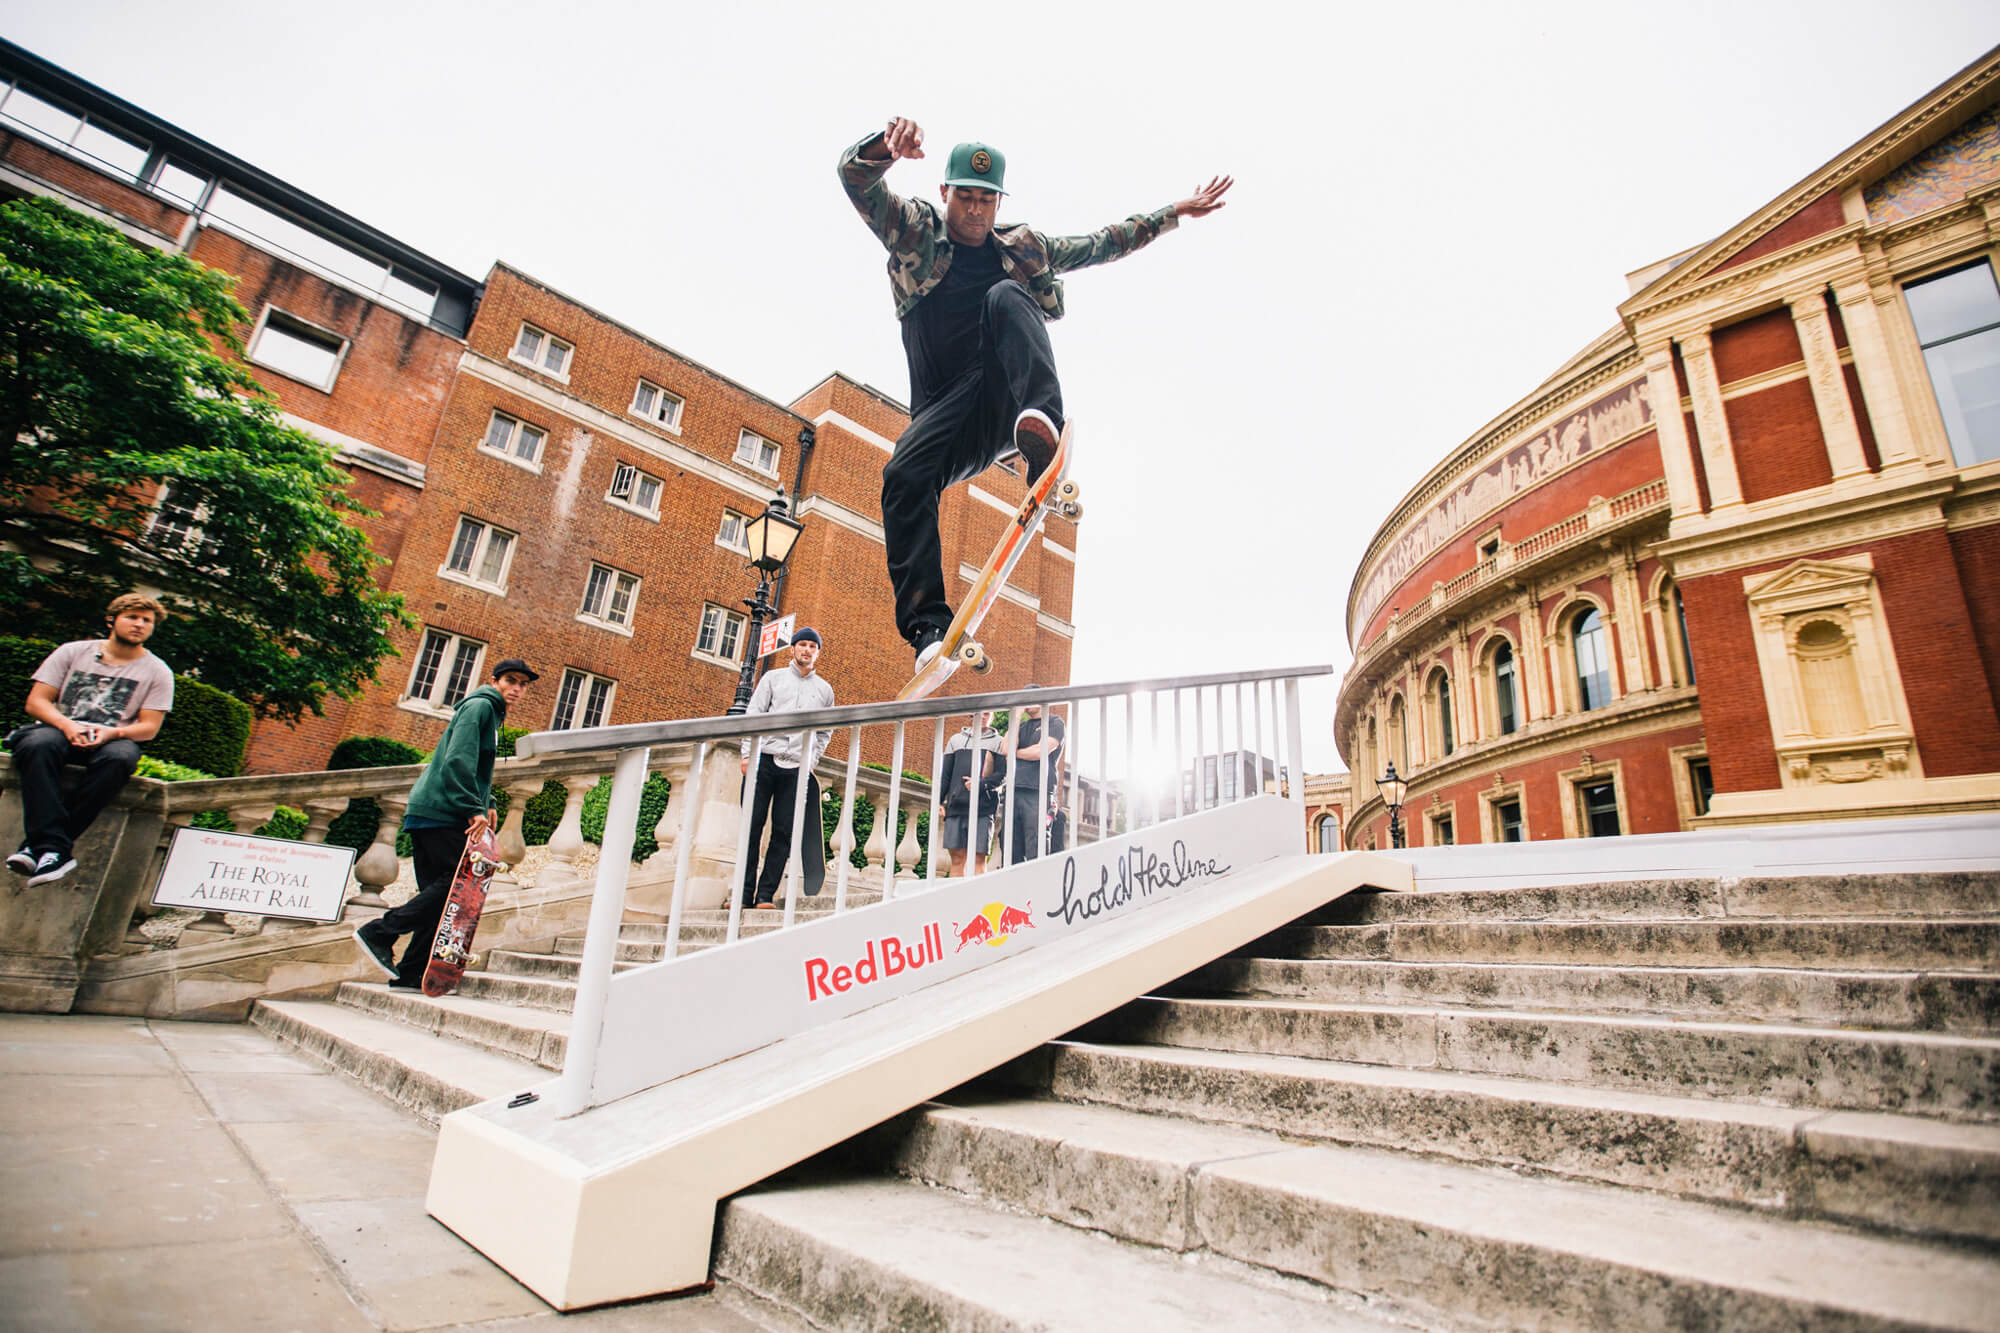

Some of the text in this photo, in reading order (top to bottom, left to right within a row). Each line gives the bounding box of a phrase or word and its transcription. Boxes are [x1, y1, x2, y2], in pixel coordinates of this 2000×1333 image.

[208, 860, 310, 888] THE ROYAL
[190, 882, 312, 909] ALBERT RAIL
[804, 921, 944, 1002] Red Bull
